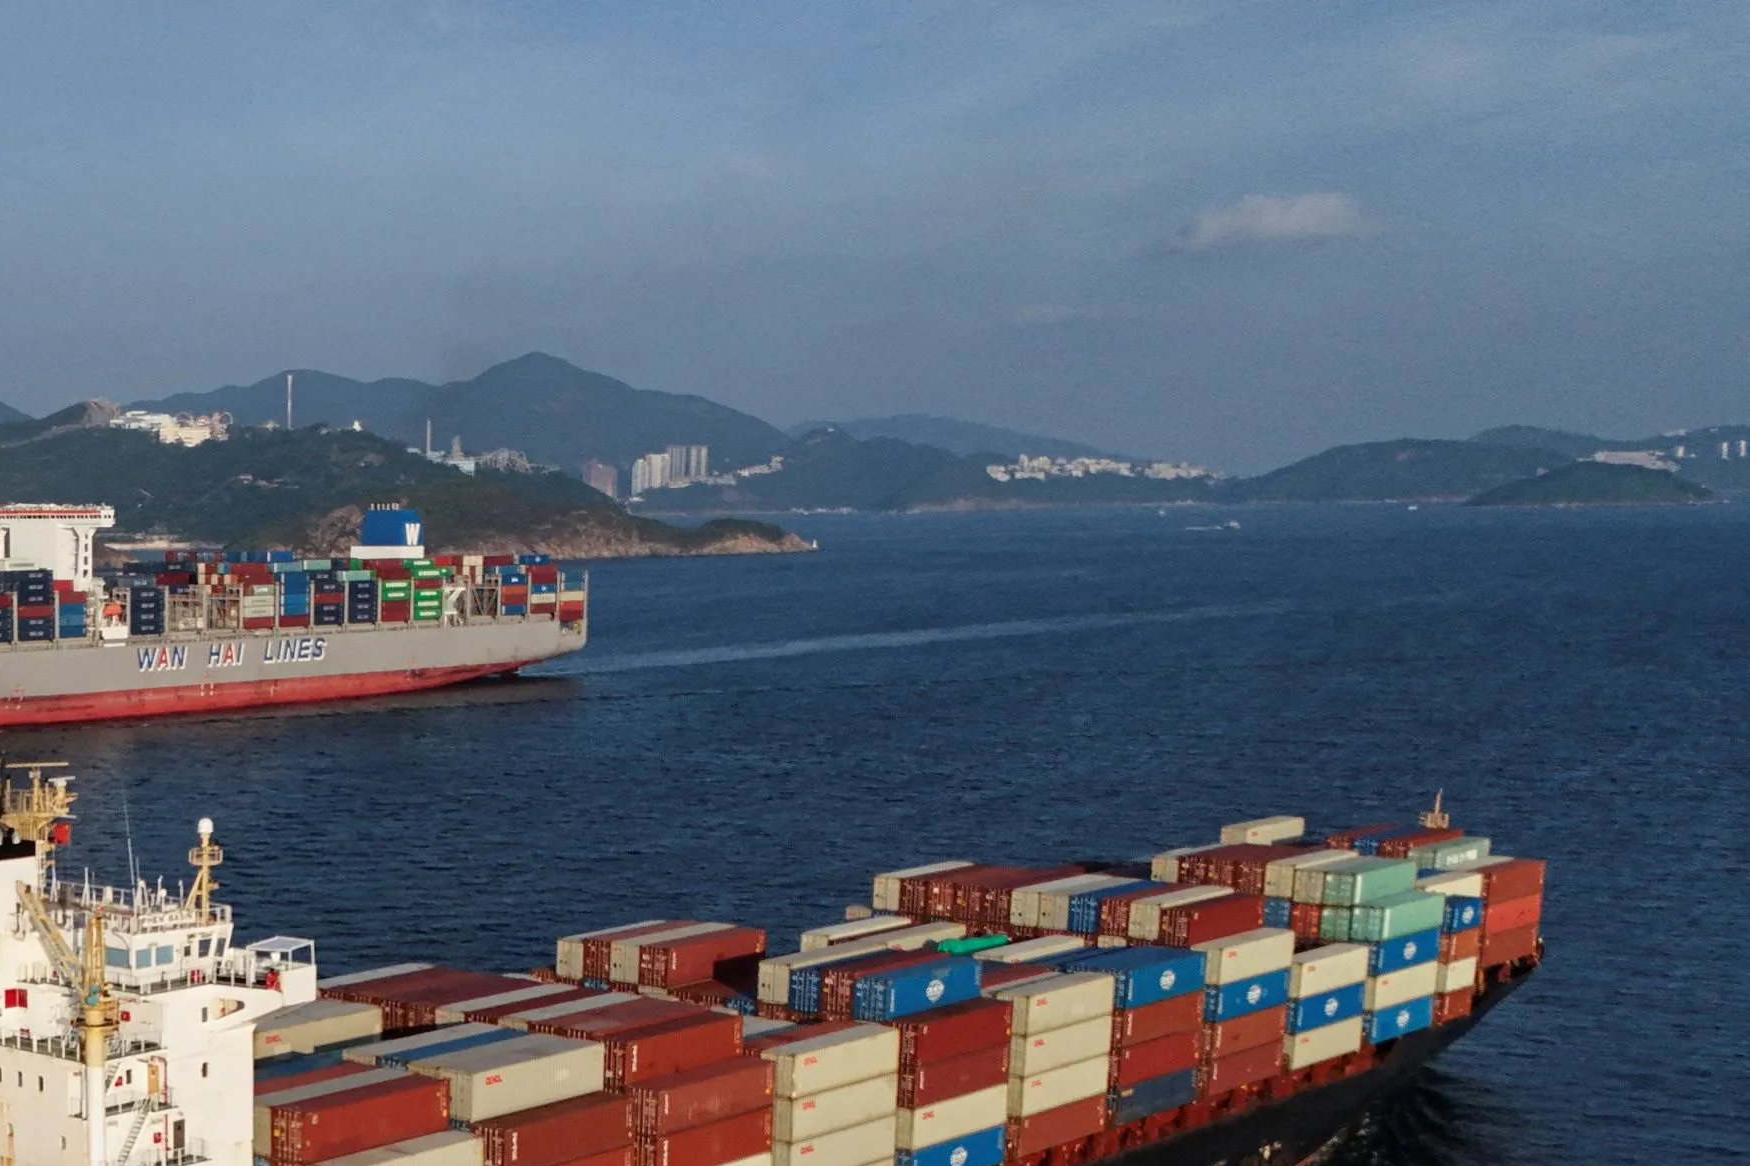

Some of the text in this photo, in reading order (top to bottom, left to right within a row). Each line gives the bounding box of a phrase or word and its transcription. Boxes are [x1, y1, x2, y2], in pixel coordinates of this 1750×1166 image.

[404, 522, 421, 545] W
[137, 637, 328, 672] WAN HAI LINES
